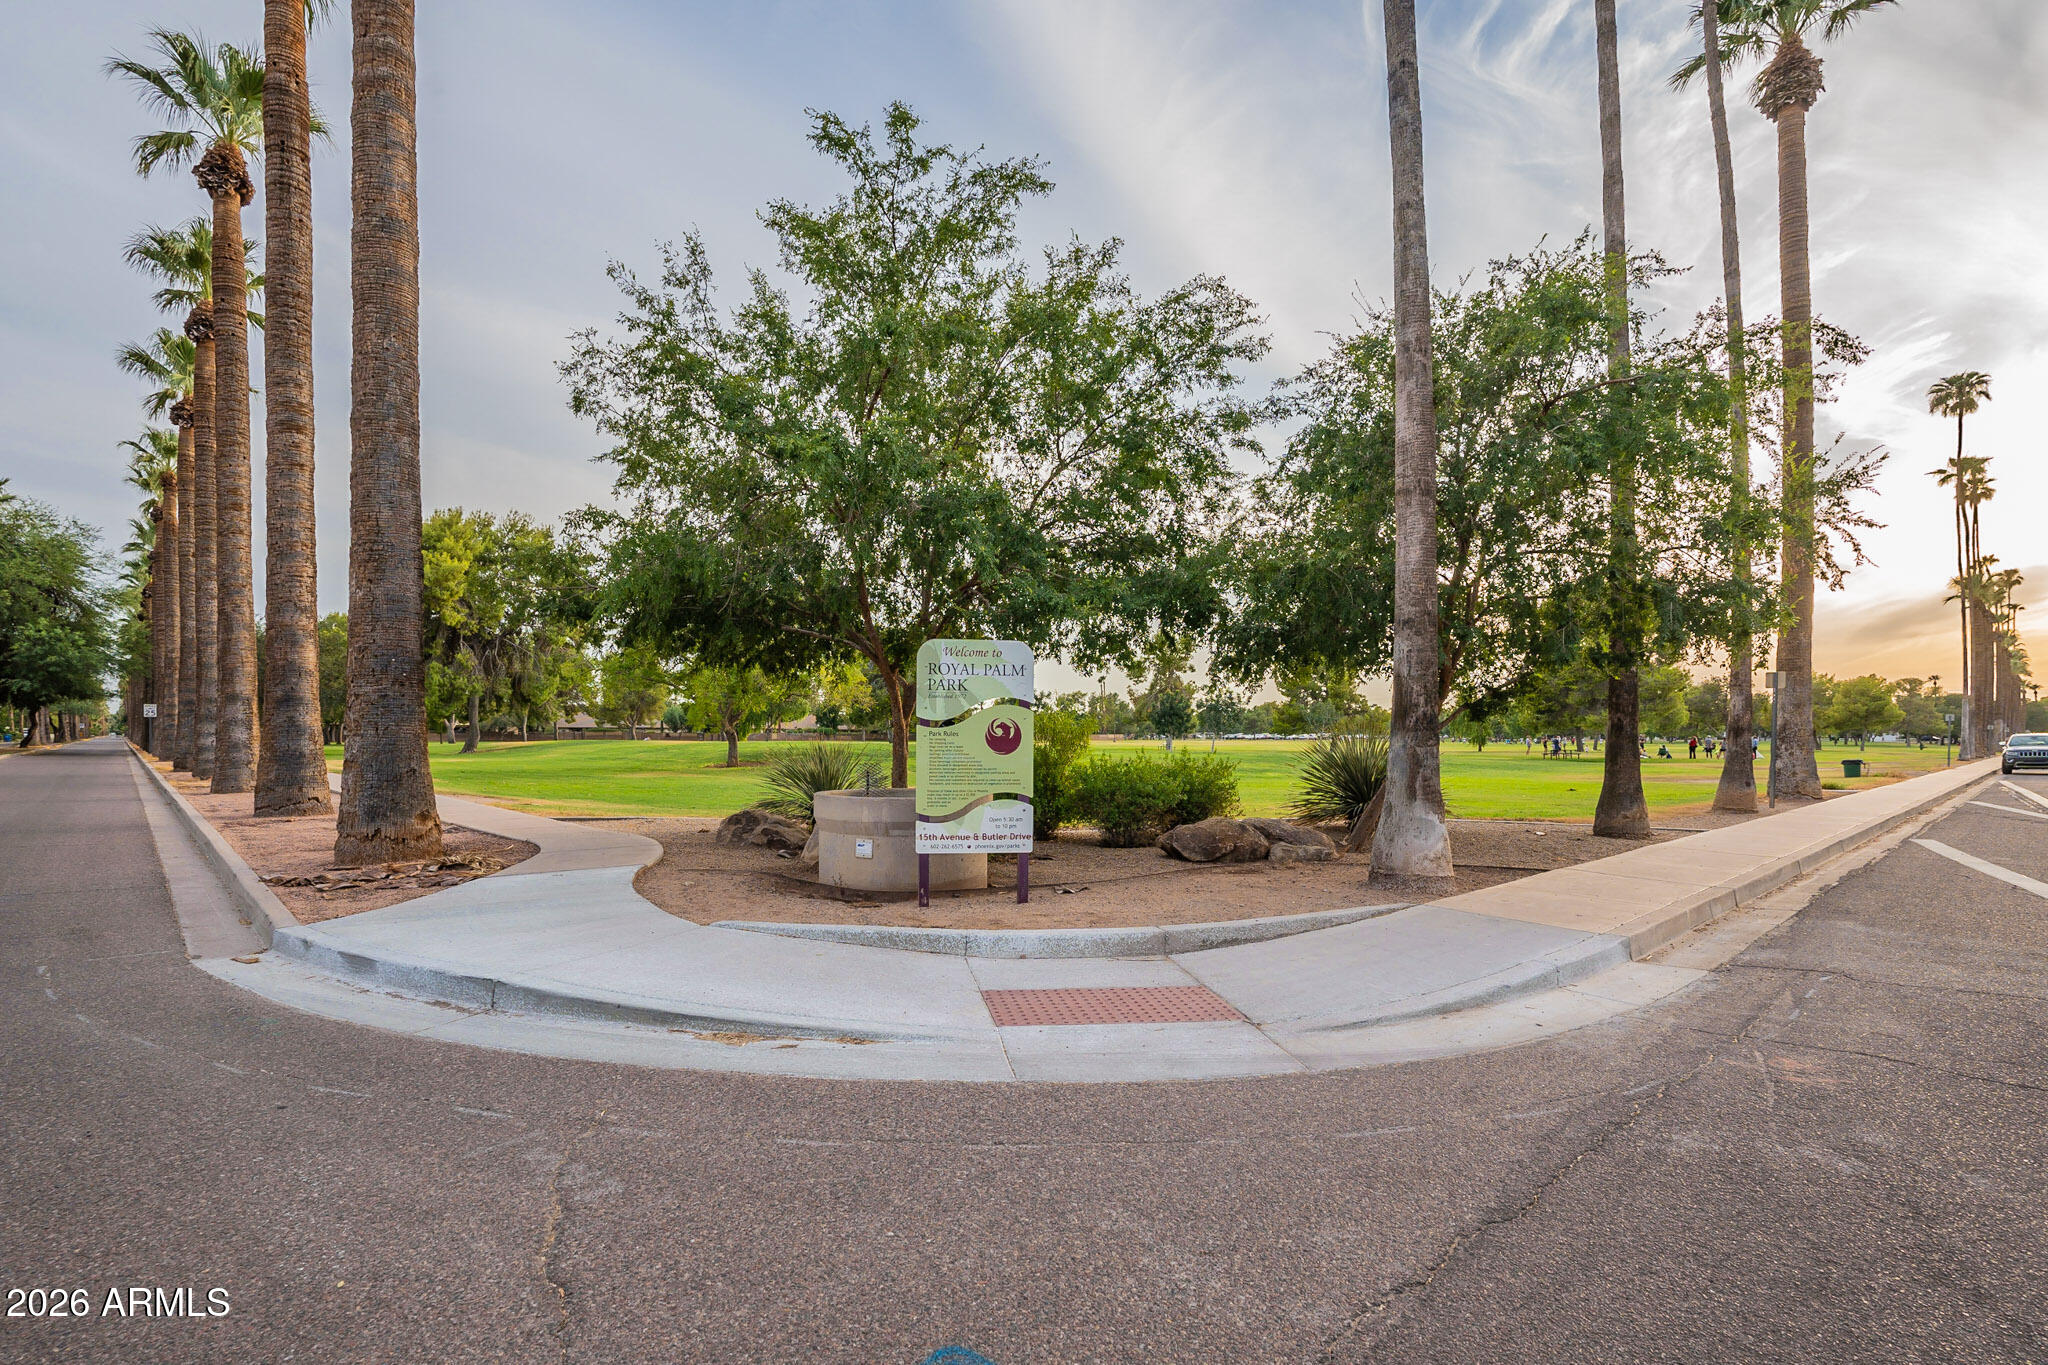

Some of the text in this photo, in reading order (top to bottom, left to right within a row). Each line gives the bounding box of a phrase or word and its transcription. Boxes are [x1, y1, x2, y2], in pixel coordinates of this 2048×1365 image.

[943, 646, 1002, 657] Welcome to
[928, 663, 1024, 676] ROYAL PALM
[928, 679, 968, 691] PARK
[973, 833, 979, 841] &
